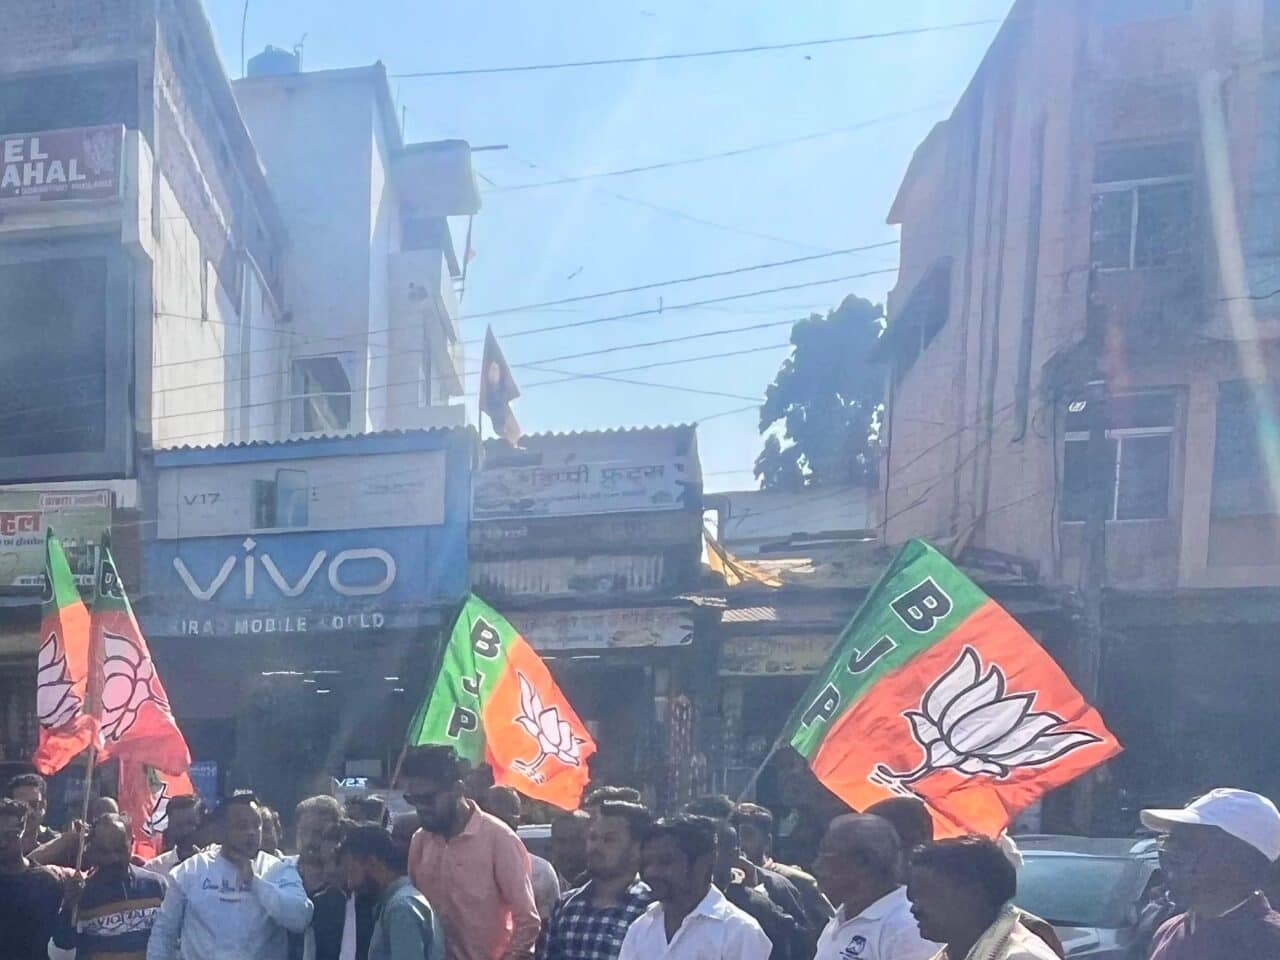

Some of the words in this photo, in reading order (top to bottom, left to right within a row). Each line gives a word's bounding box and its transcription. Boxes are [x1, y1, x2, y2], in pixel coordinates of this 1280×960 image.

[183, 492, 221, 506] V17
[234, 616, 308, 635] MOBILE
[801, 575, 954, 729] BJP
